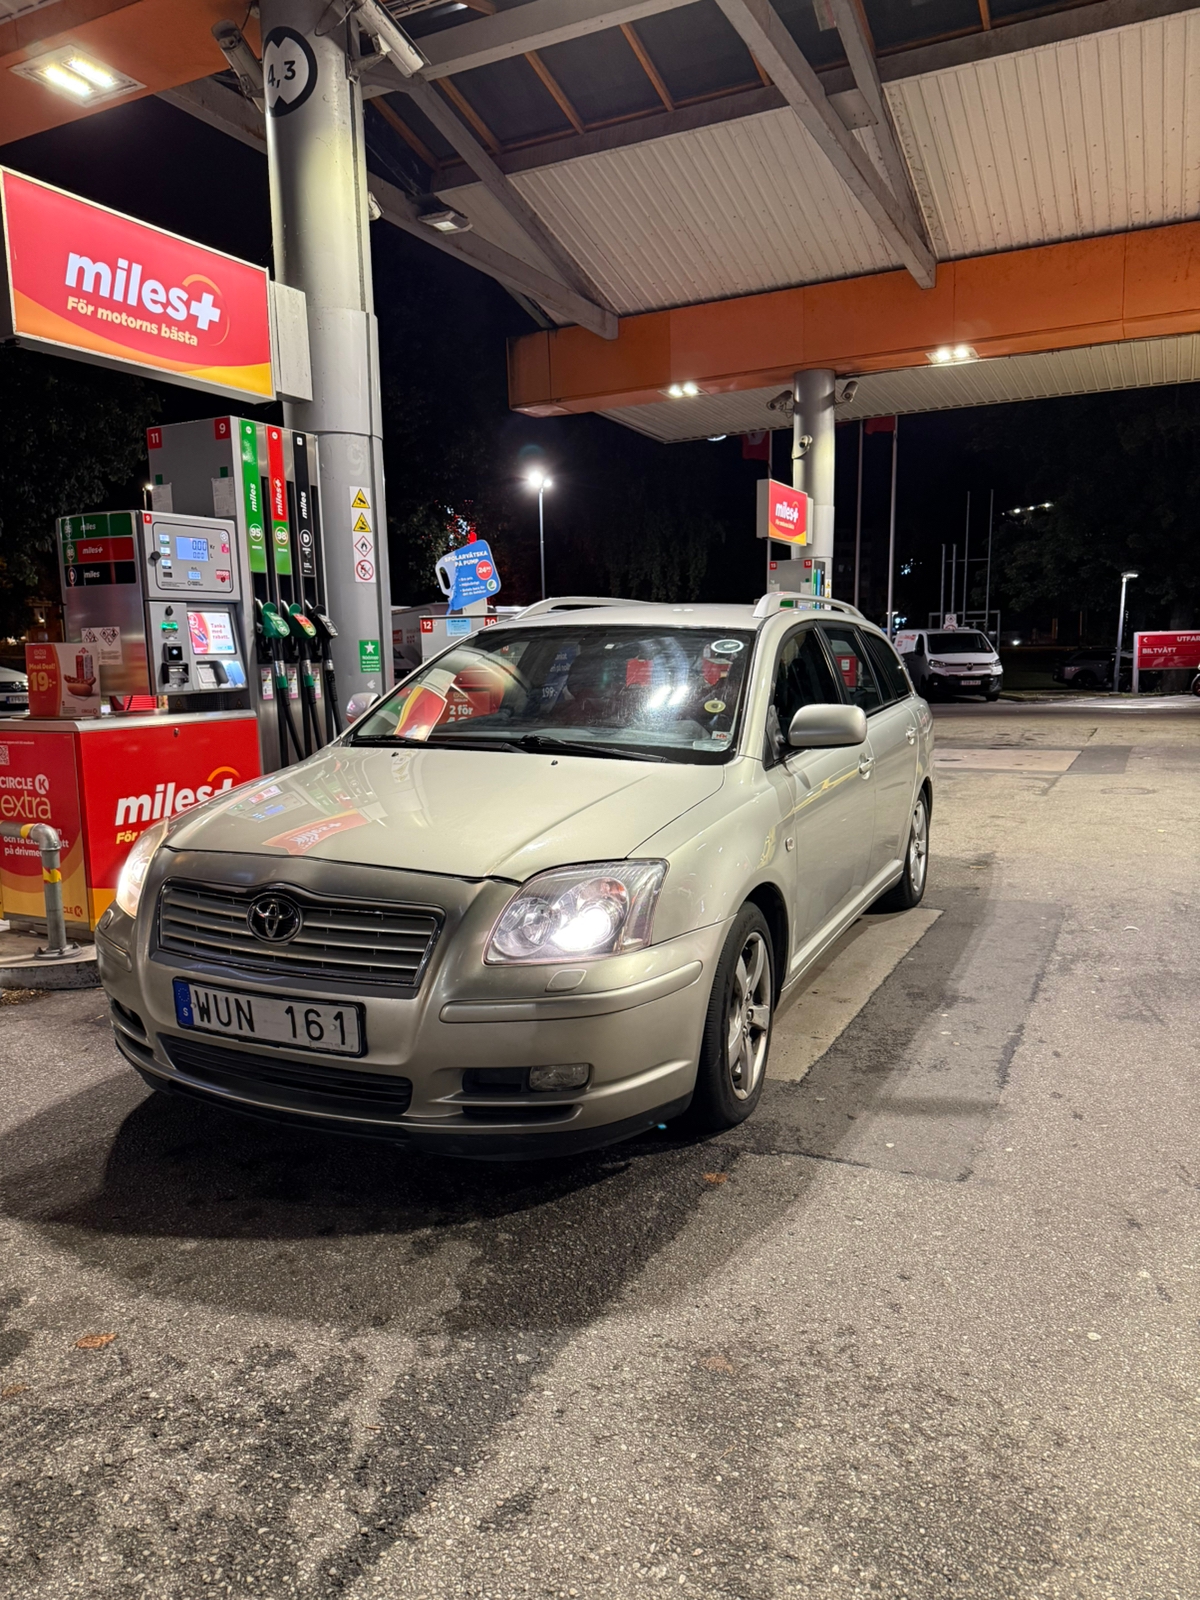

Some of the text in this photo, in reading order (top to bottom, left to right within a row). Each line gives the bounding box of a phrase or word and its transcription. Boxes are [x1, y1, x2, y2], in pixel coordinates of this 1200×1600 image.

[65, 252, 221, 330] miles+
[66, 296, 198, 346] För motorns bästa
[219, 423, 226, 434] 9
[151, 433, 159, 443] 11
[250, 527, 262, 537] 95
[277, 531, 287, 541] 98
[423, 621, 432, 629] 12
[449, 704, 473, 715] 2 för
[0, 774, 49, 795] CIRCLE K
[0, 790, 52, 819] extra
[116, 831, 137, 844] För
[5, 844, 42, 857] på drivme
[183, 1007, 189, 1017] S
[194, 990, 346, 1045] WUN 161
